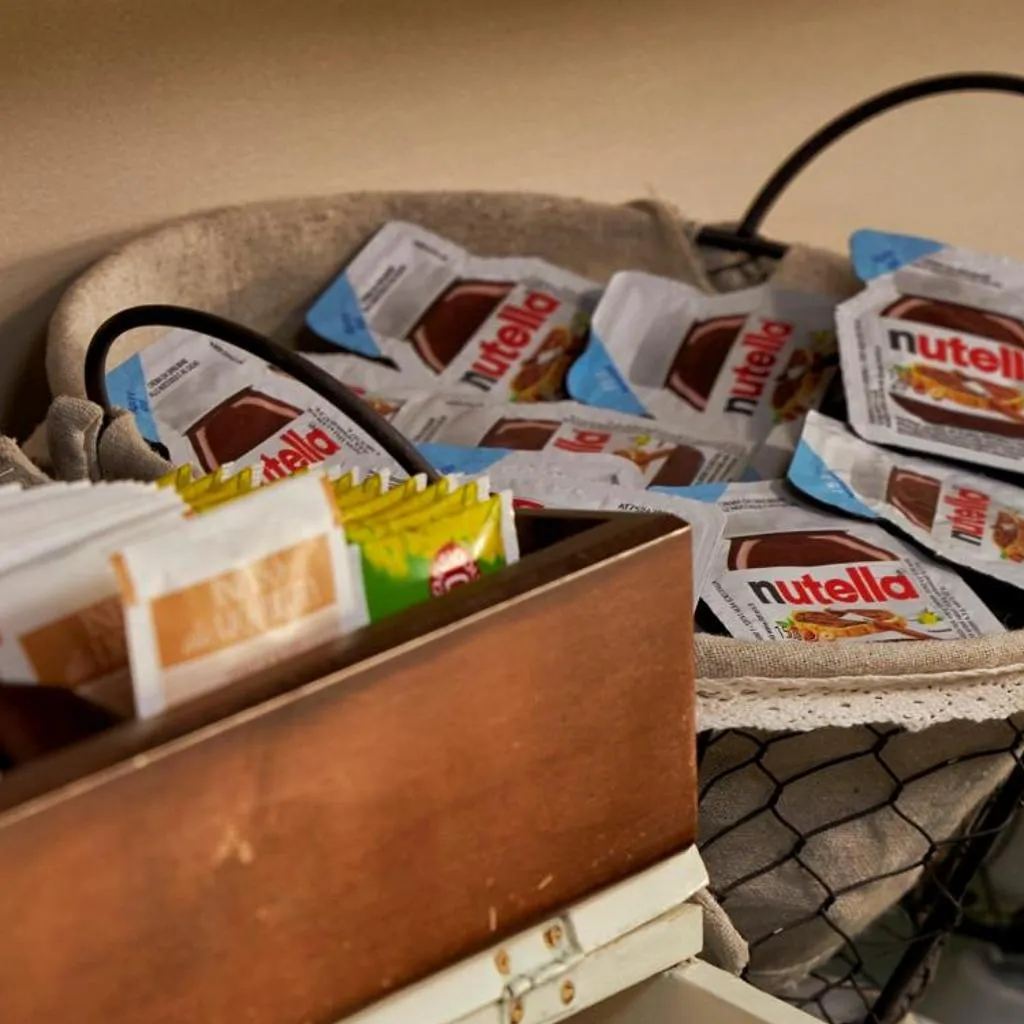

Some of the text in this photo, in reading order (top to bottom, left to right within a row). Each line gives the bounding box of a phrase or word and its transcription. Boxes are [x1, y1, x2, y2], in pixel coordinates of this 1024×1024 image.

[460, 290, 562, 392] nutella
[725, 318, 794, 416] nutella
[260, 427, 341, 484] tella
[944, 486, 990, 546] nutella
[747, 565, 921, 605] nutella
